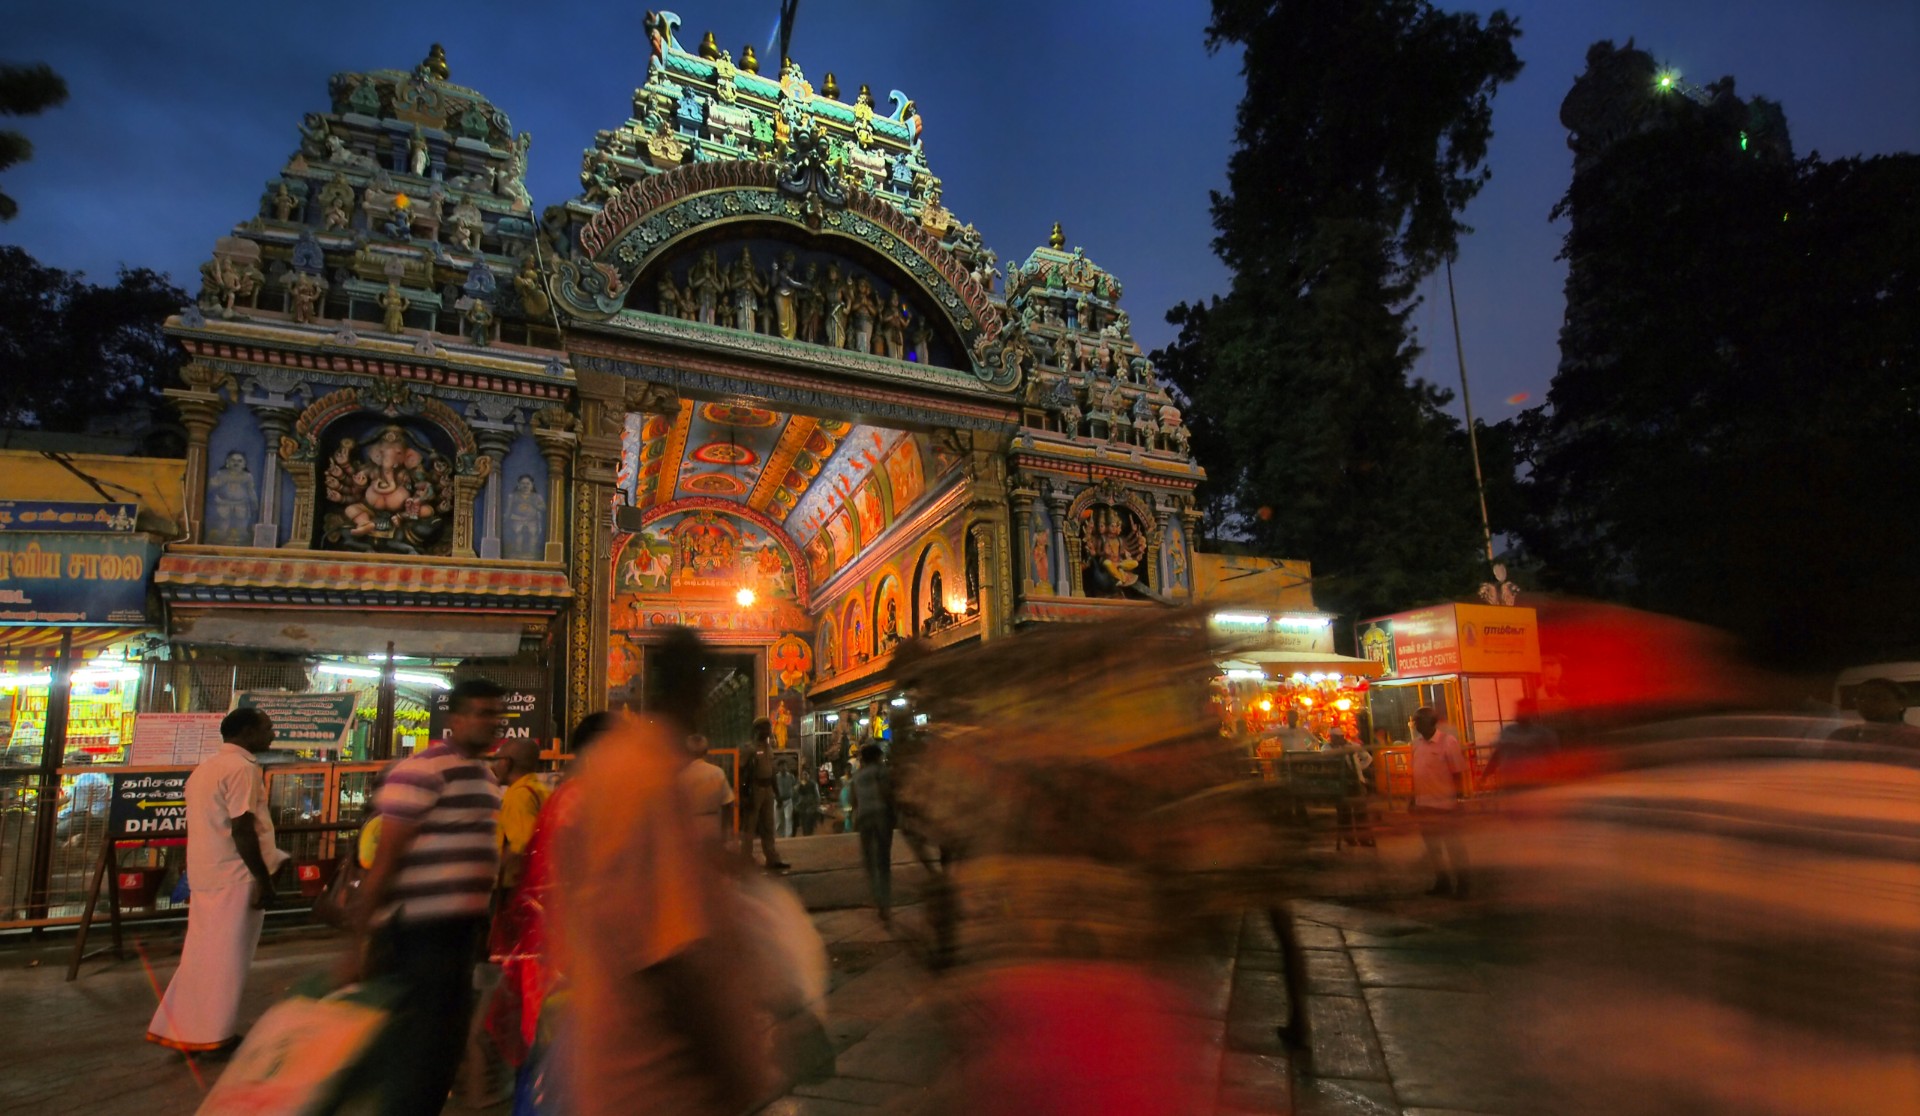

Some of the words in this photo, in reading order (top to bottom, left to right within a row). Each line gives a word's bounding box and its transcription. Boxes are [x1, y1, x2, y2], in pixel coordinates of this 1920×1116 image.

[67, 553, 143, 580] சாலை
[1399, 656, 1418, 670] POLICE
[1418, 655, 1433, 668] HELP
[1433, 651, 1458, 666] CENTRE
[155, 807, 186, 817] WAY
